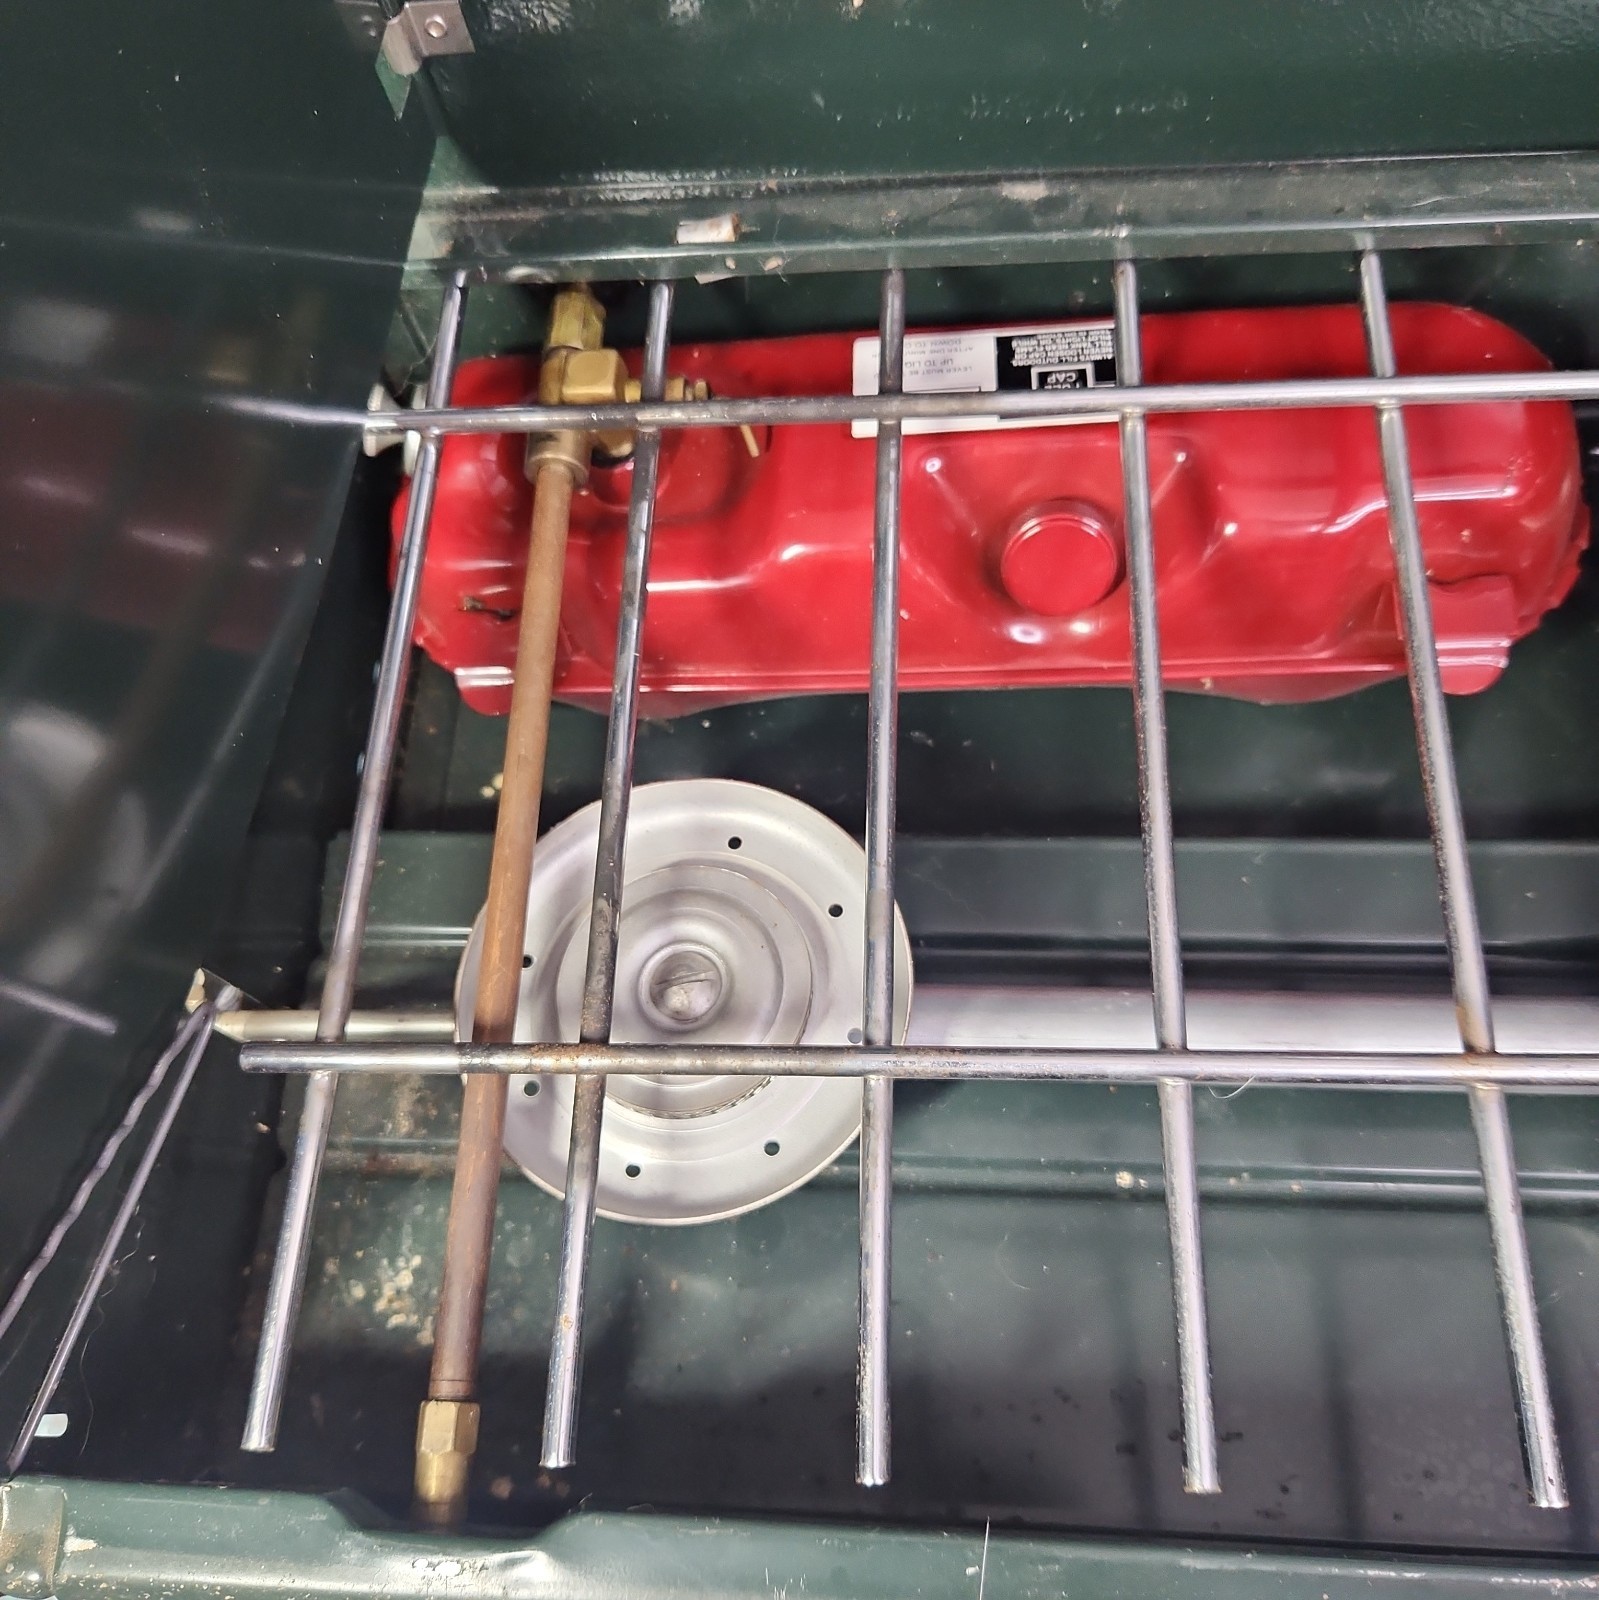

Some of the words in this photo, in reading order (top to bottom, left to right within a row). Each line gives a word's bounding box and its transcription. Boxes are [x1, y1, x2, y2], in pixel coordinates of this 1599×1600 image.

[930, 338, 961, 347] DOWN
[946, 345, 973, 353] AFTER
[1083, 346, 1112, 354] NEVER
[939, 357, 953, 365] UP
[1079, 353, 1112, 361] ALWAYS
[903, 360, 920, 369] LIG
[923, 359, 936, 367] TO
[921, 367, 943, 375] MUST
[945, 365, 972, 373] LEVER
[1047, 372, 1076, 382] CAP
